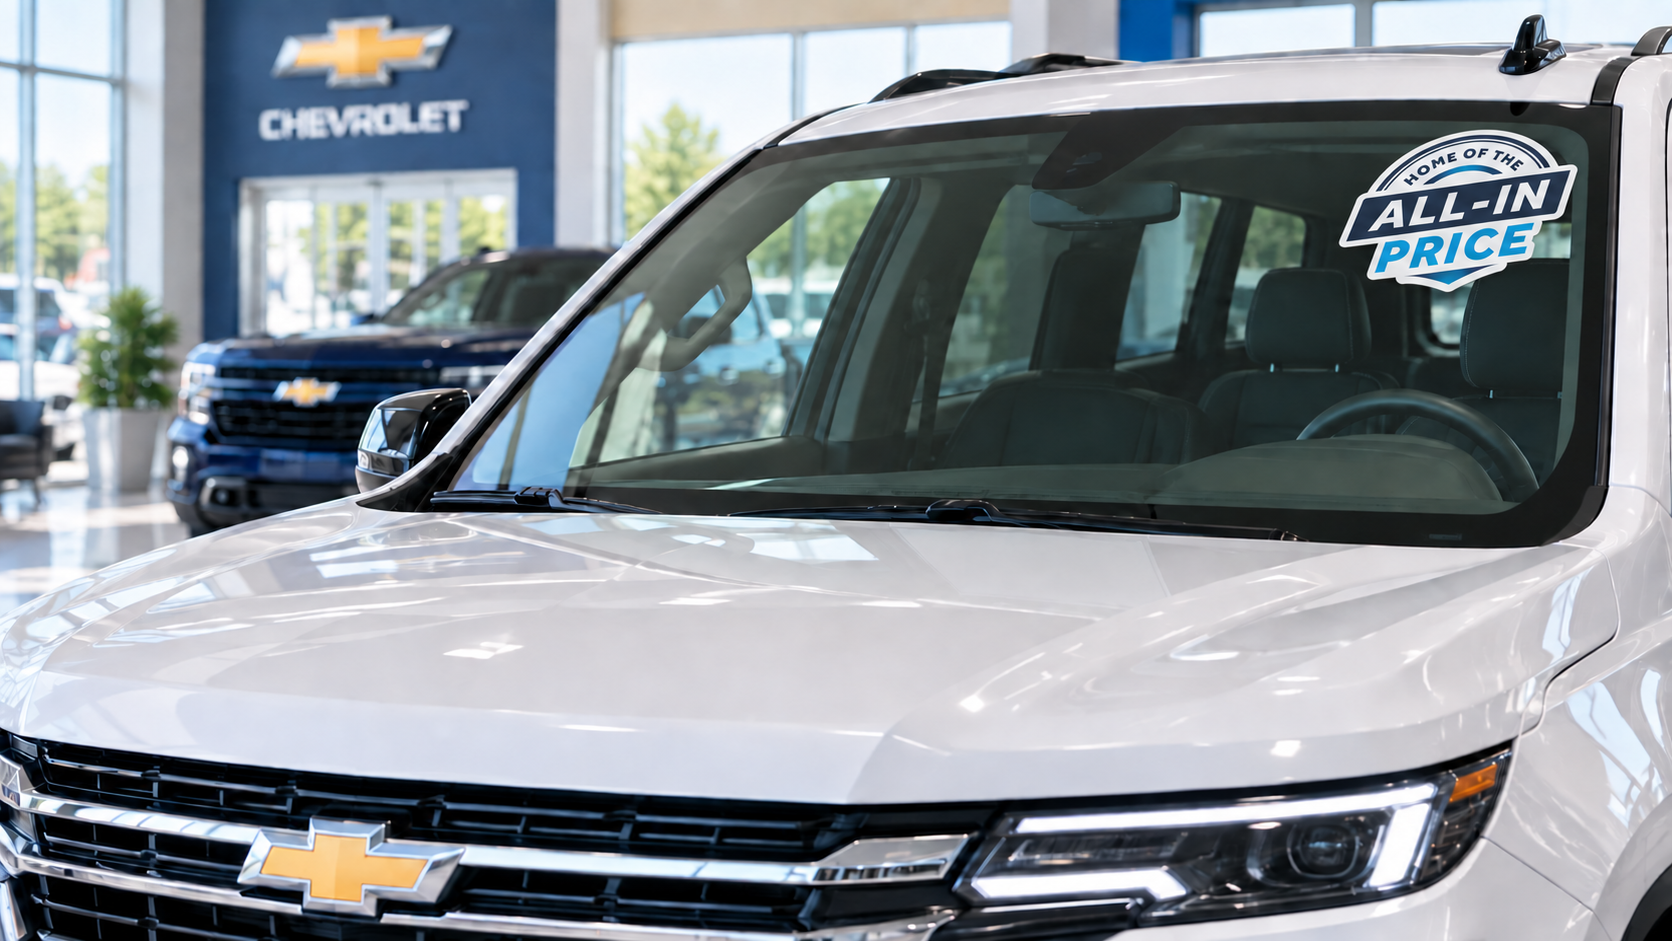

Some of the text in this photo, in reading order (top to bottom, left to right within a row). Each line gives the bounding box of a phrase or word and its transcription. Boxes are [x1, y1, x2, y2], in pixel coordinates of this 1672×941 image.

[259, 99, 470, 141] CHEVROLET
[1403, 148, 1524, 186] HOME OF THE
[1367, 179, 1551, 232] ALL-IN
[1374, 222, 1535, 274] PRICE
